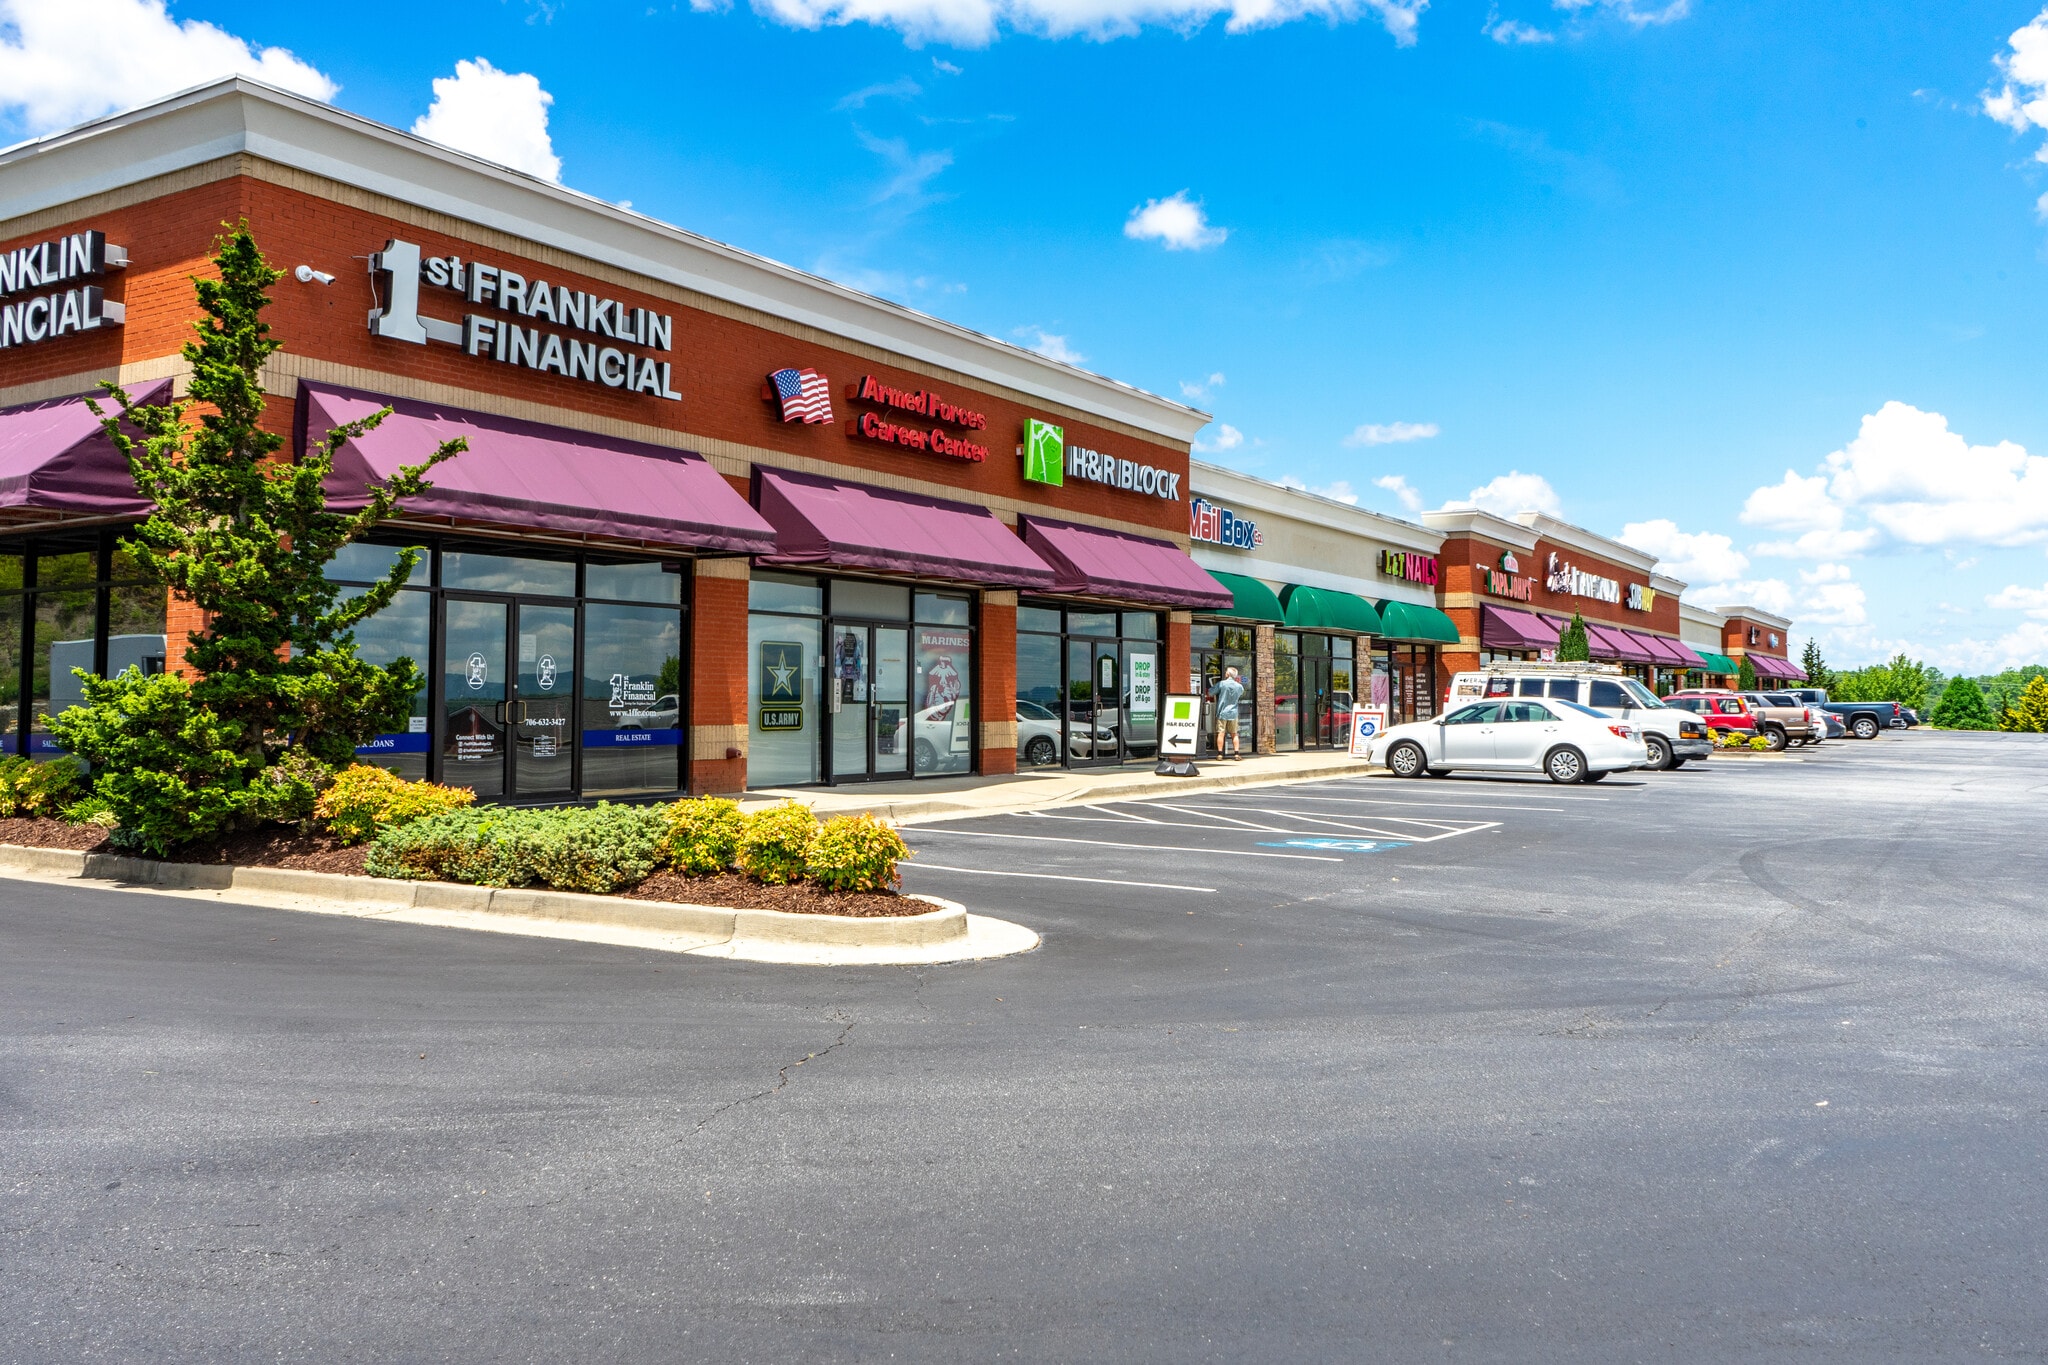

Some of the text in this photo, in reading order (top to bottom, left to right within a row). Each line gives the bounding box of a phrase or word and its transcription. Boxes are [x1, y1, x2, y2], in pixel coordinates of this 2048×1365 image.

[0, 286, 101, 347] NCIAL
[469, 261, 672, 352] FRANKLIN
[465, 313, 682, 401] FINANCIAL
[862, 375, 987, 431] Armed Forces
[862, 411, 989, 463] Career Center
[1068, 445, 1180, 501] H&R BLOCK
[1405, 552, 1439, 586] NAILS
[1489, 569, 1509, 597] PAPA
[1626, 582, 1656, 613] SUBWAY
[922, 635, 970, 647] MARINES
[1135, 661, 1151, 671] DROP
[623, 681, 654, 691] Franklin
[623, 691, 656, 701] Financial
[1135, 685, 1151, 694] DROP
[369, 739, 394, 748] OANS
[615, 733, 652, 742] REAL ESTATE
